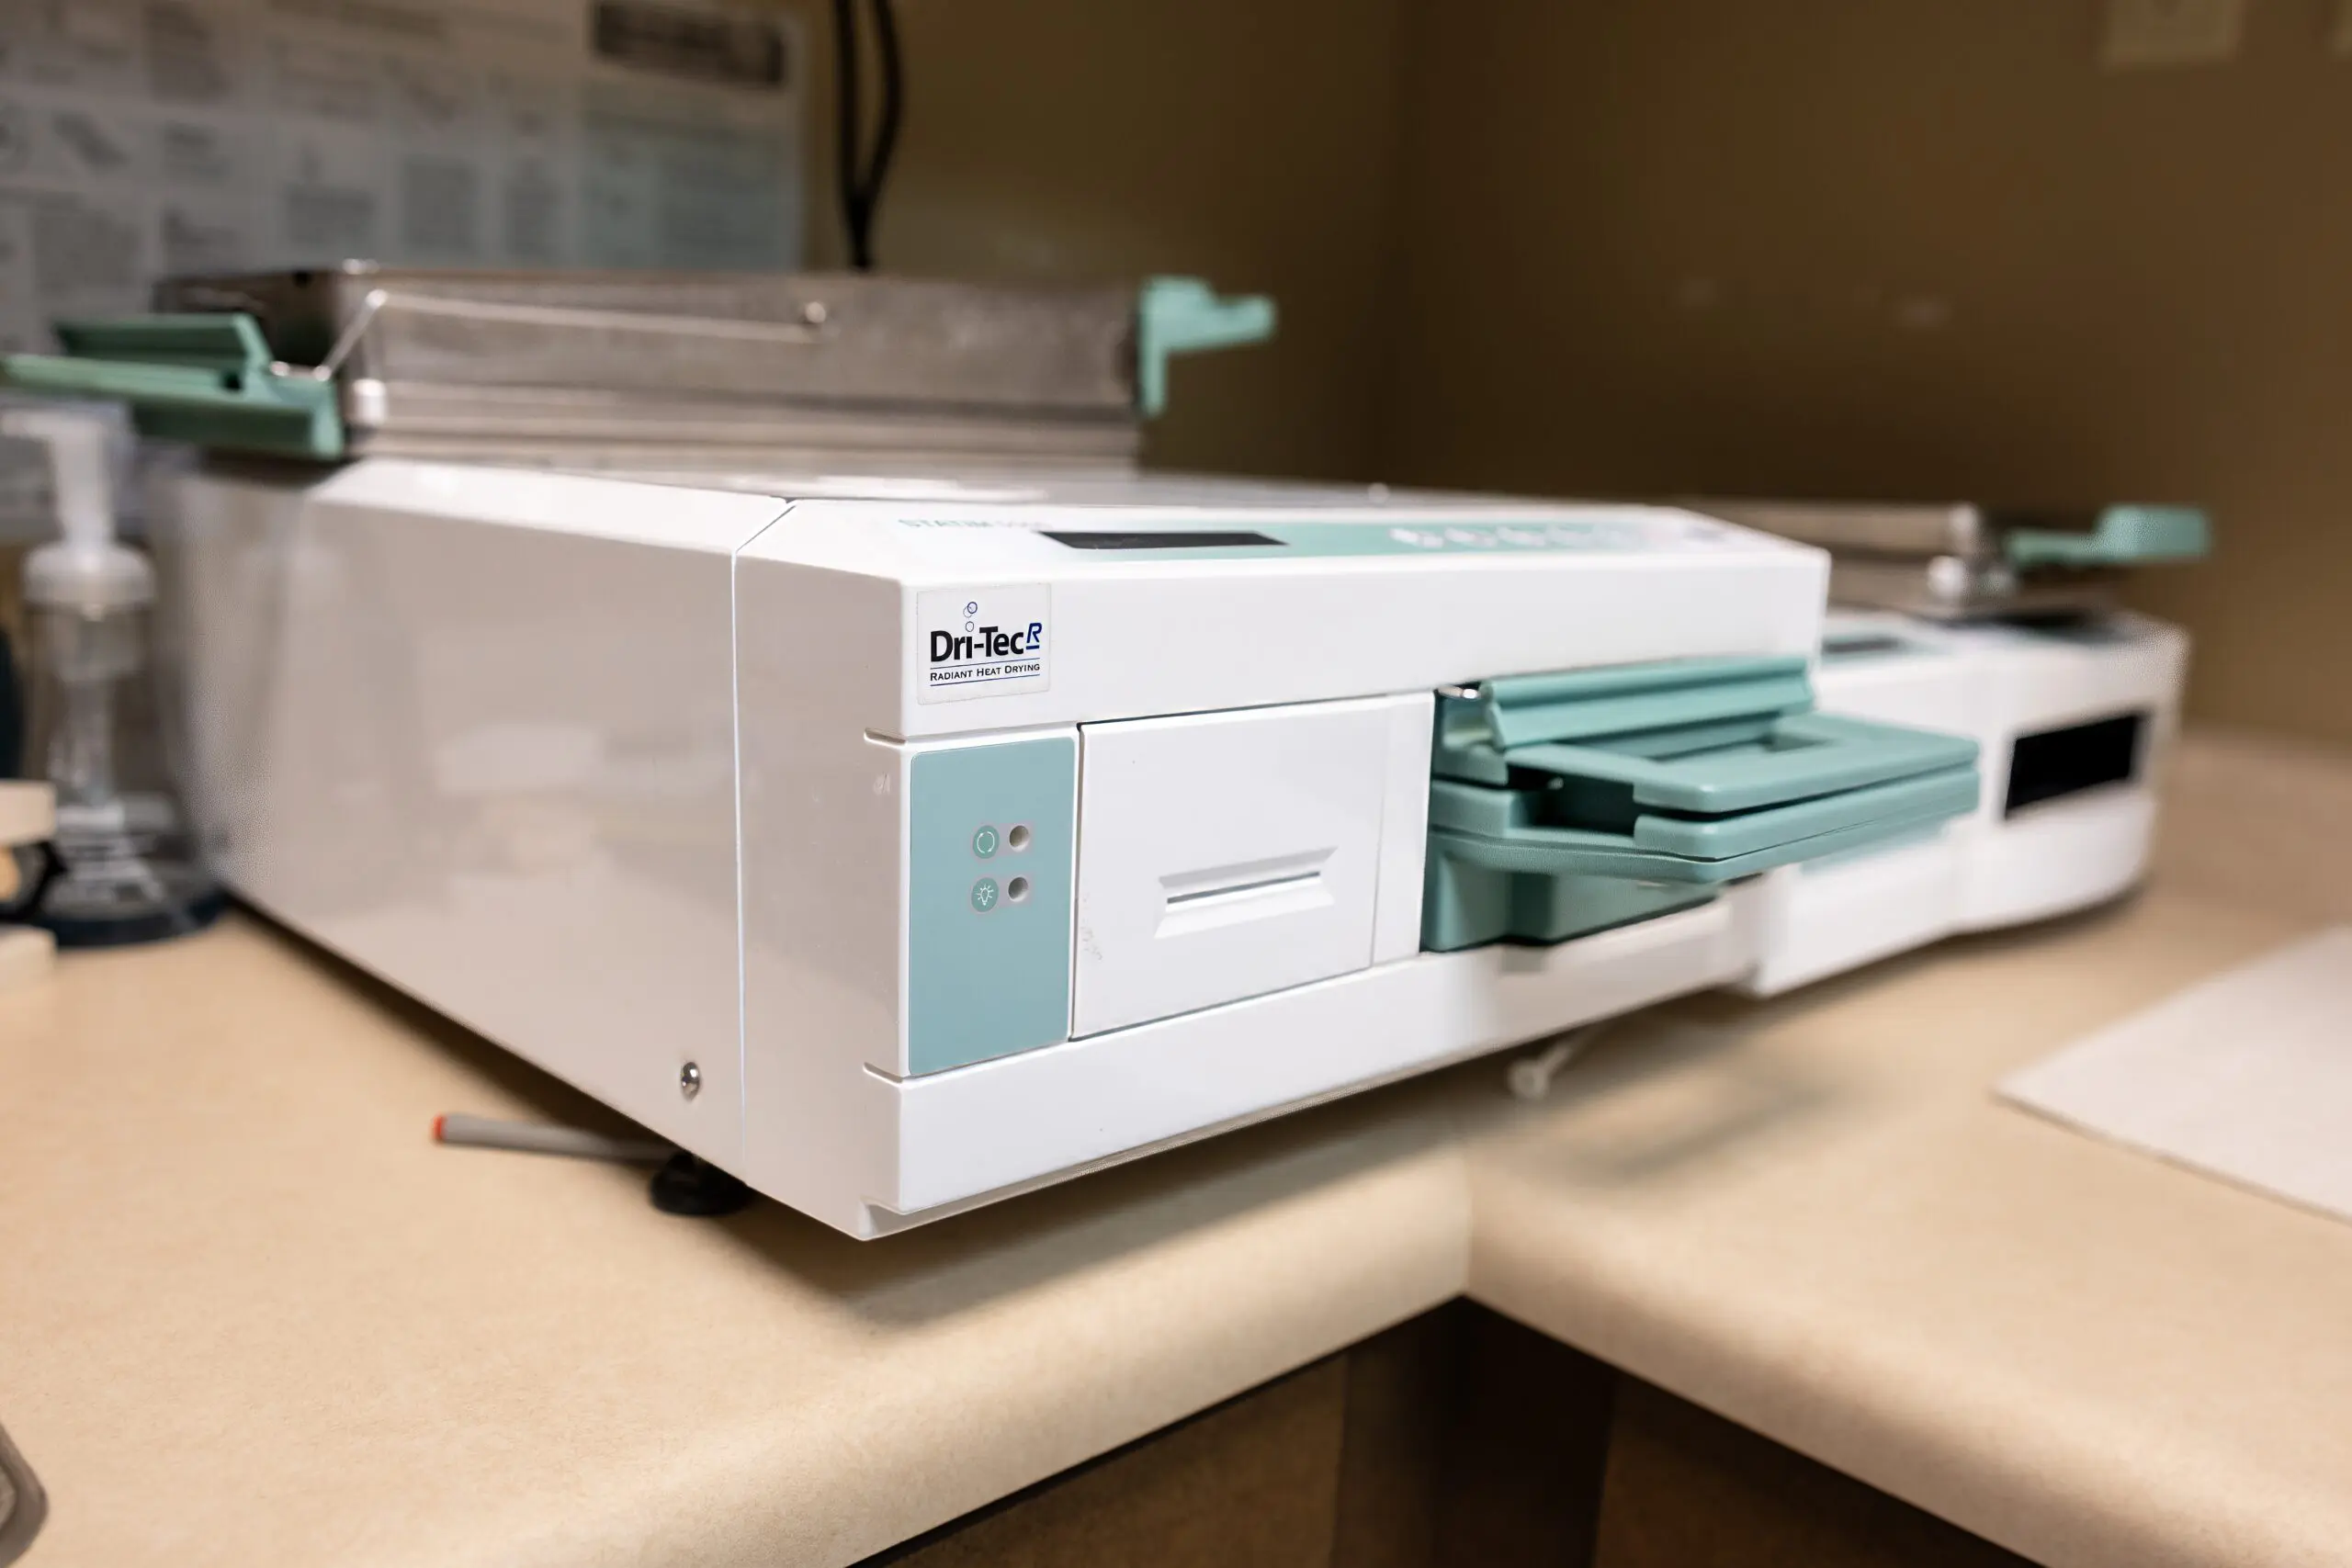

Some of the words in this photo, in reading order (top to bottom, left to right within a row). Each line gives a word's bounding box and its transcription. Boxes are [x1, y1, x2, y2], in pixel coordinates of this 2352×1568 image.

[930, 670, 973, 682] RADIANT
[977, 667, 1002, 677] HEAT
[1004, 663, 1040, 674] DRYING
